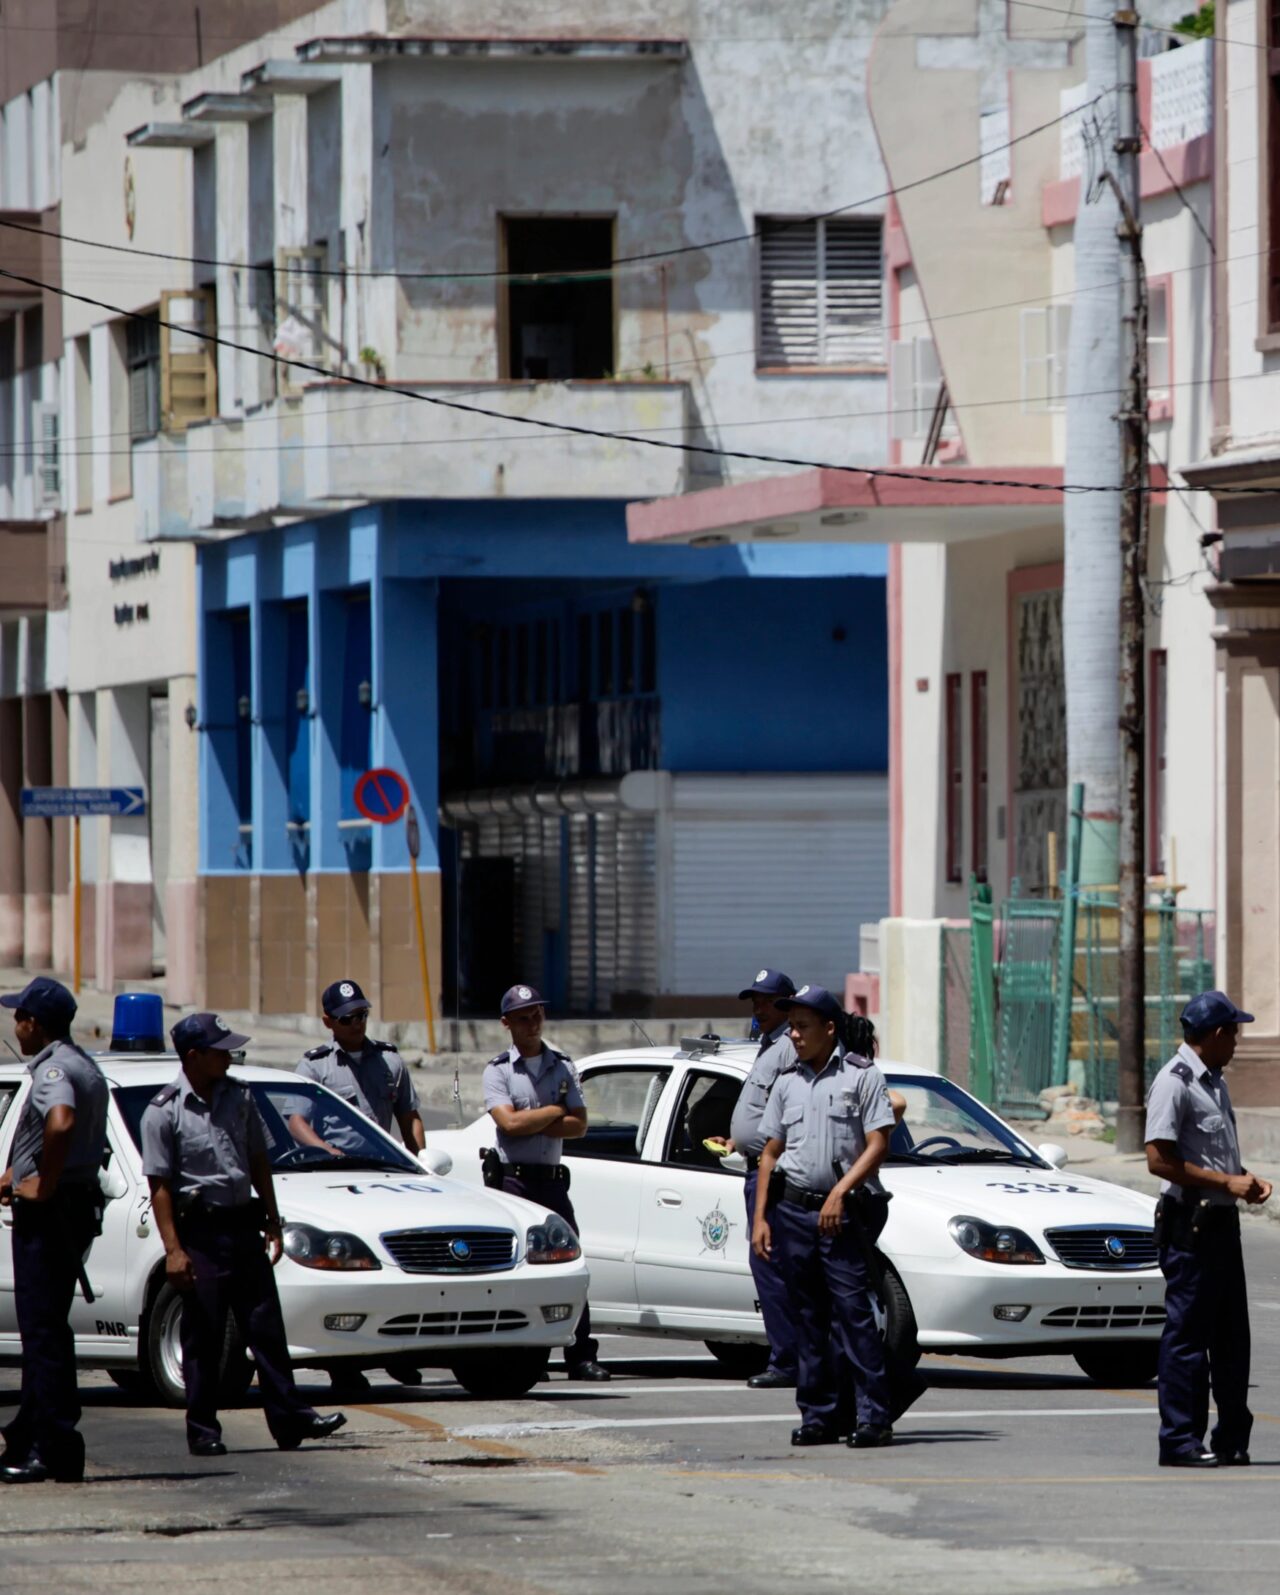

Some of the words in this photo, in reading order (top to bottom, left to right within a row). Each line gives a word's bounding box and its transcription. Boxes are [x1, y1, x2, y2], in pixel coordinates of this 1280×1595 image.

[326, 1184, 443, 1194] 710
[986, 1182, 1094, 1194] 332
[140, 1211, 149, 1225] C
[96, 1320, 128, 1337] PNR
